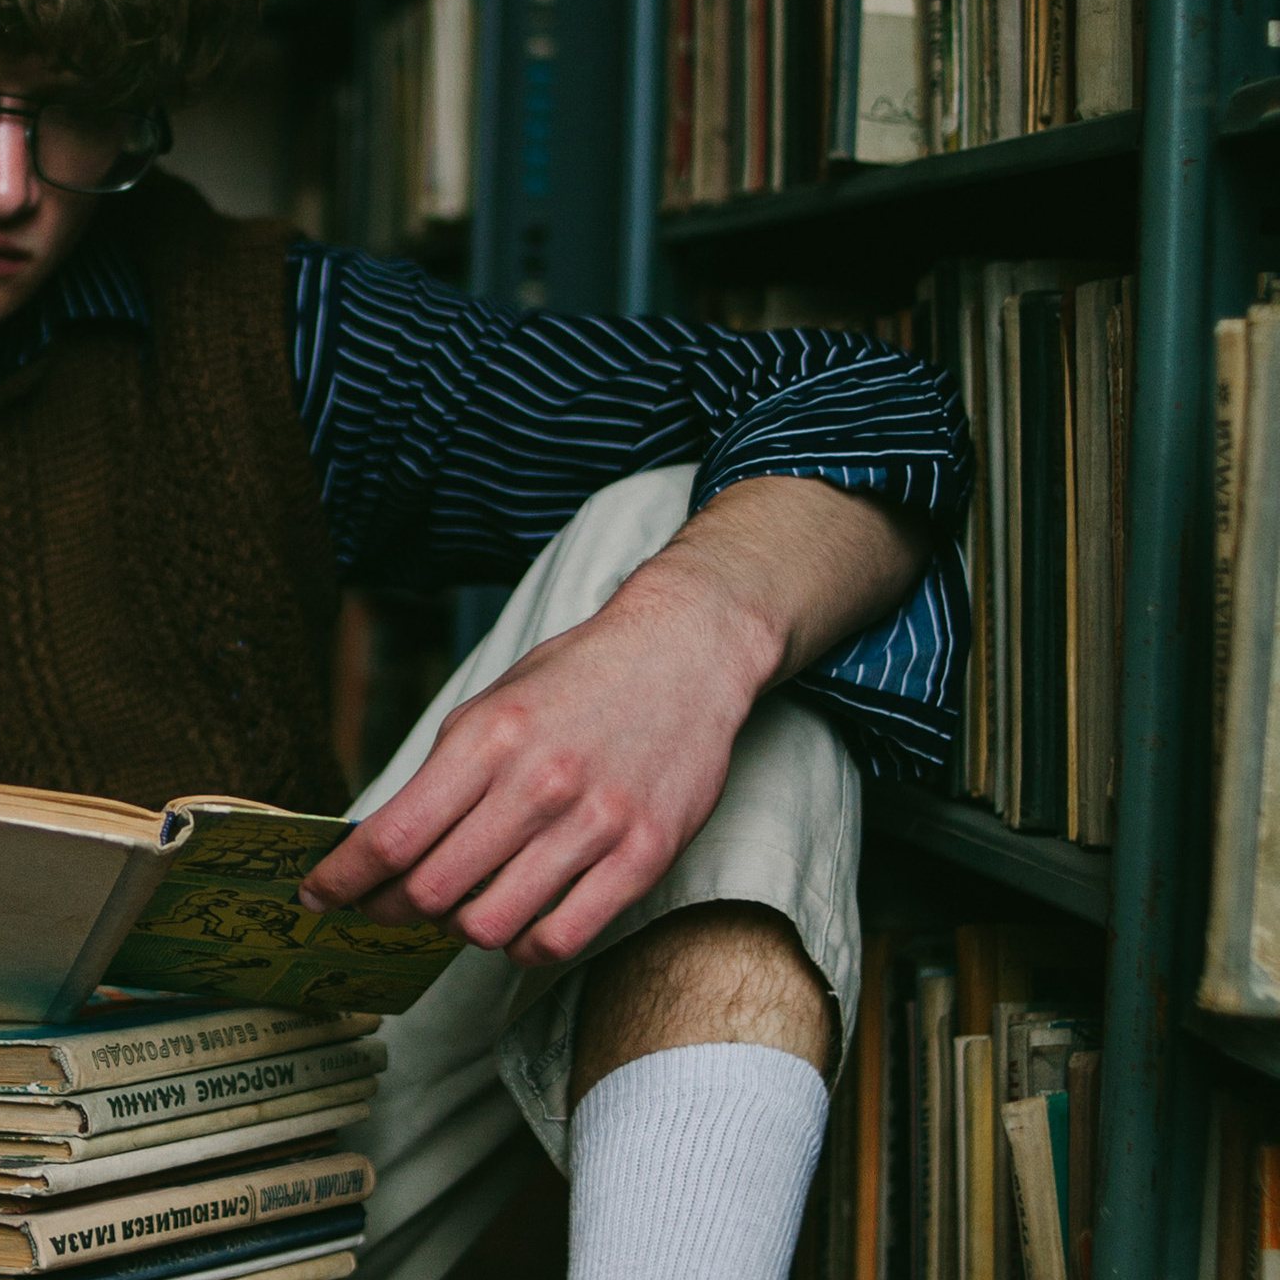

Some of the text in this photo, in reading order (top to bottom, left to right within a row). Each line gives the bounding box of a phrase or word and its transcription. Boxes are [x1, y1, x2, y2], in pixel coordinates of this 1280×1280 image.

[90, 1033, 192, 1071] ПАРОХОДЫ
[193, 1020, 259, 1052] БЕЛЫЕ
[195, 1061, 296, 1104] МОРСКИЕ
[106, 1083, 187, 1119] КАМНИ
[259, 1181, 321, 1214] МАРЧЕНКО
[314, 1168, 365, 1205] АНАТОЛИЙ
[122, 1196, 250, 1241] СМЕЮЩИЕСЯ
[48, 1223, 117, 1256] ГЛАЗА
